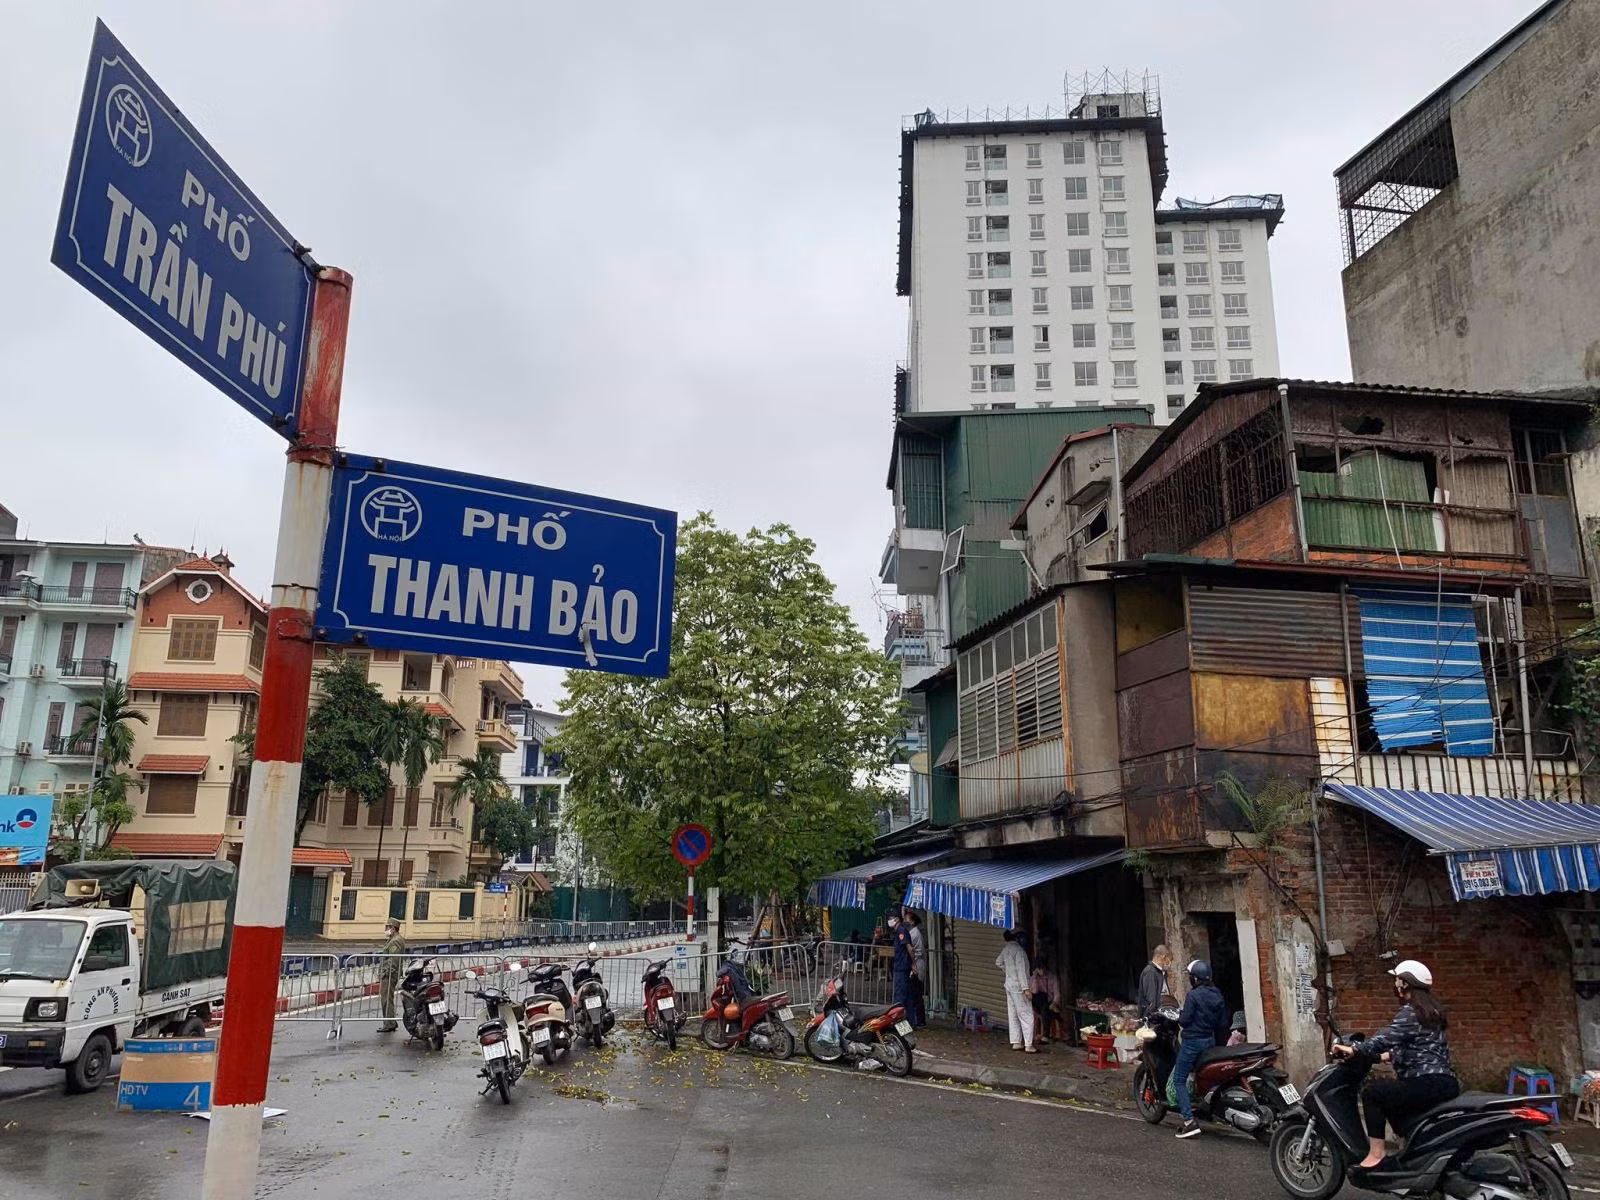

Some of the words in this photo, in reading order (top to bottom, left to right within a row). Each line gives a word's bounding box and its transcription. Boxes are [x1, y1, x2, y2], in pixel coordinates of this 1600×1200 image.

[181, 170, 256, 262] PHỐ
[103, 182, 213, 342] TRẦN
[217, 292, 287, 399] PHÚ
[462, 507, 571, 553] PHỐ
[368, 553, 534, 631] THANH
[548, 564, 638, 645] BẢO
